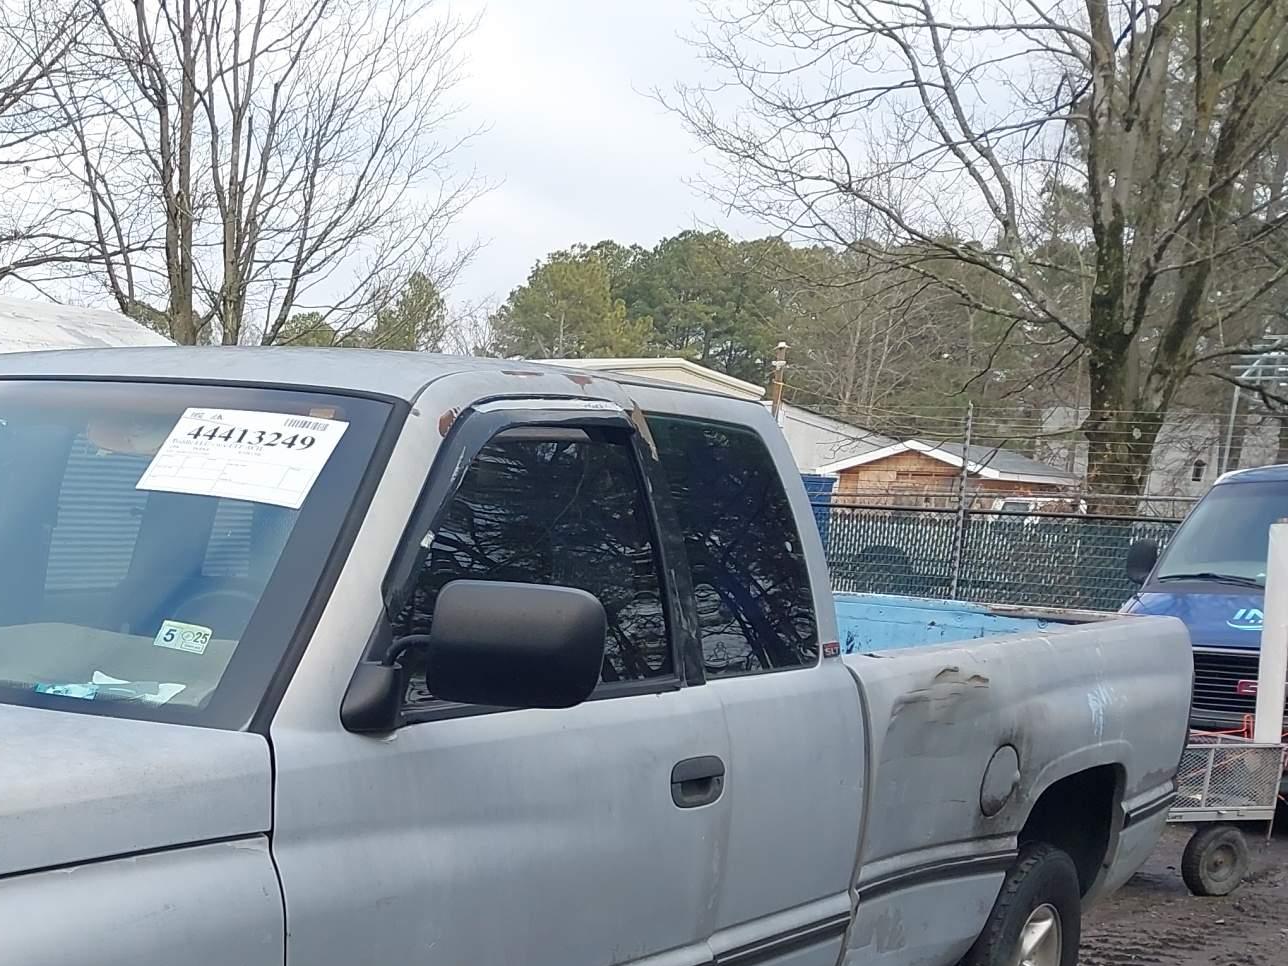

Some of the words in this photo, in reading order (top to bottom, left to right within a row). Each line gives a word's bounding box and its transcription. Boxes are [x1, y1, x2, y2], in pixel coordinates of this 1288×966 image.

[187, 425, 316, 450] 44413249
[163, 628, 177, 642] 5
[193, 631, 209, 644] 25
[824, 646, 840, 656] SLT
